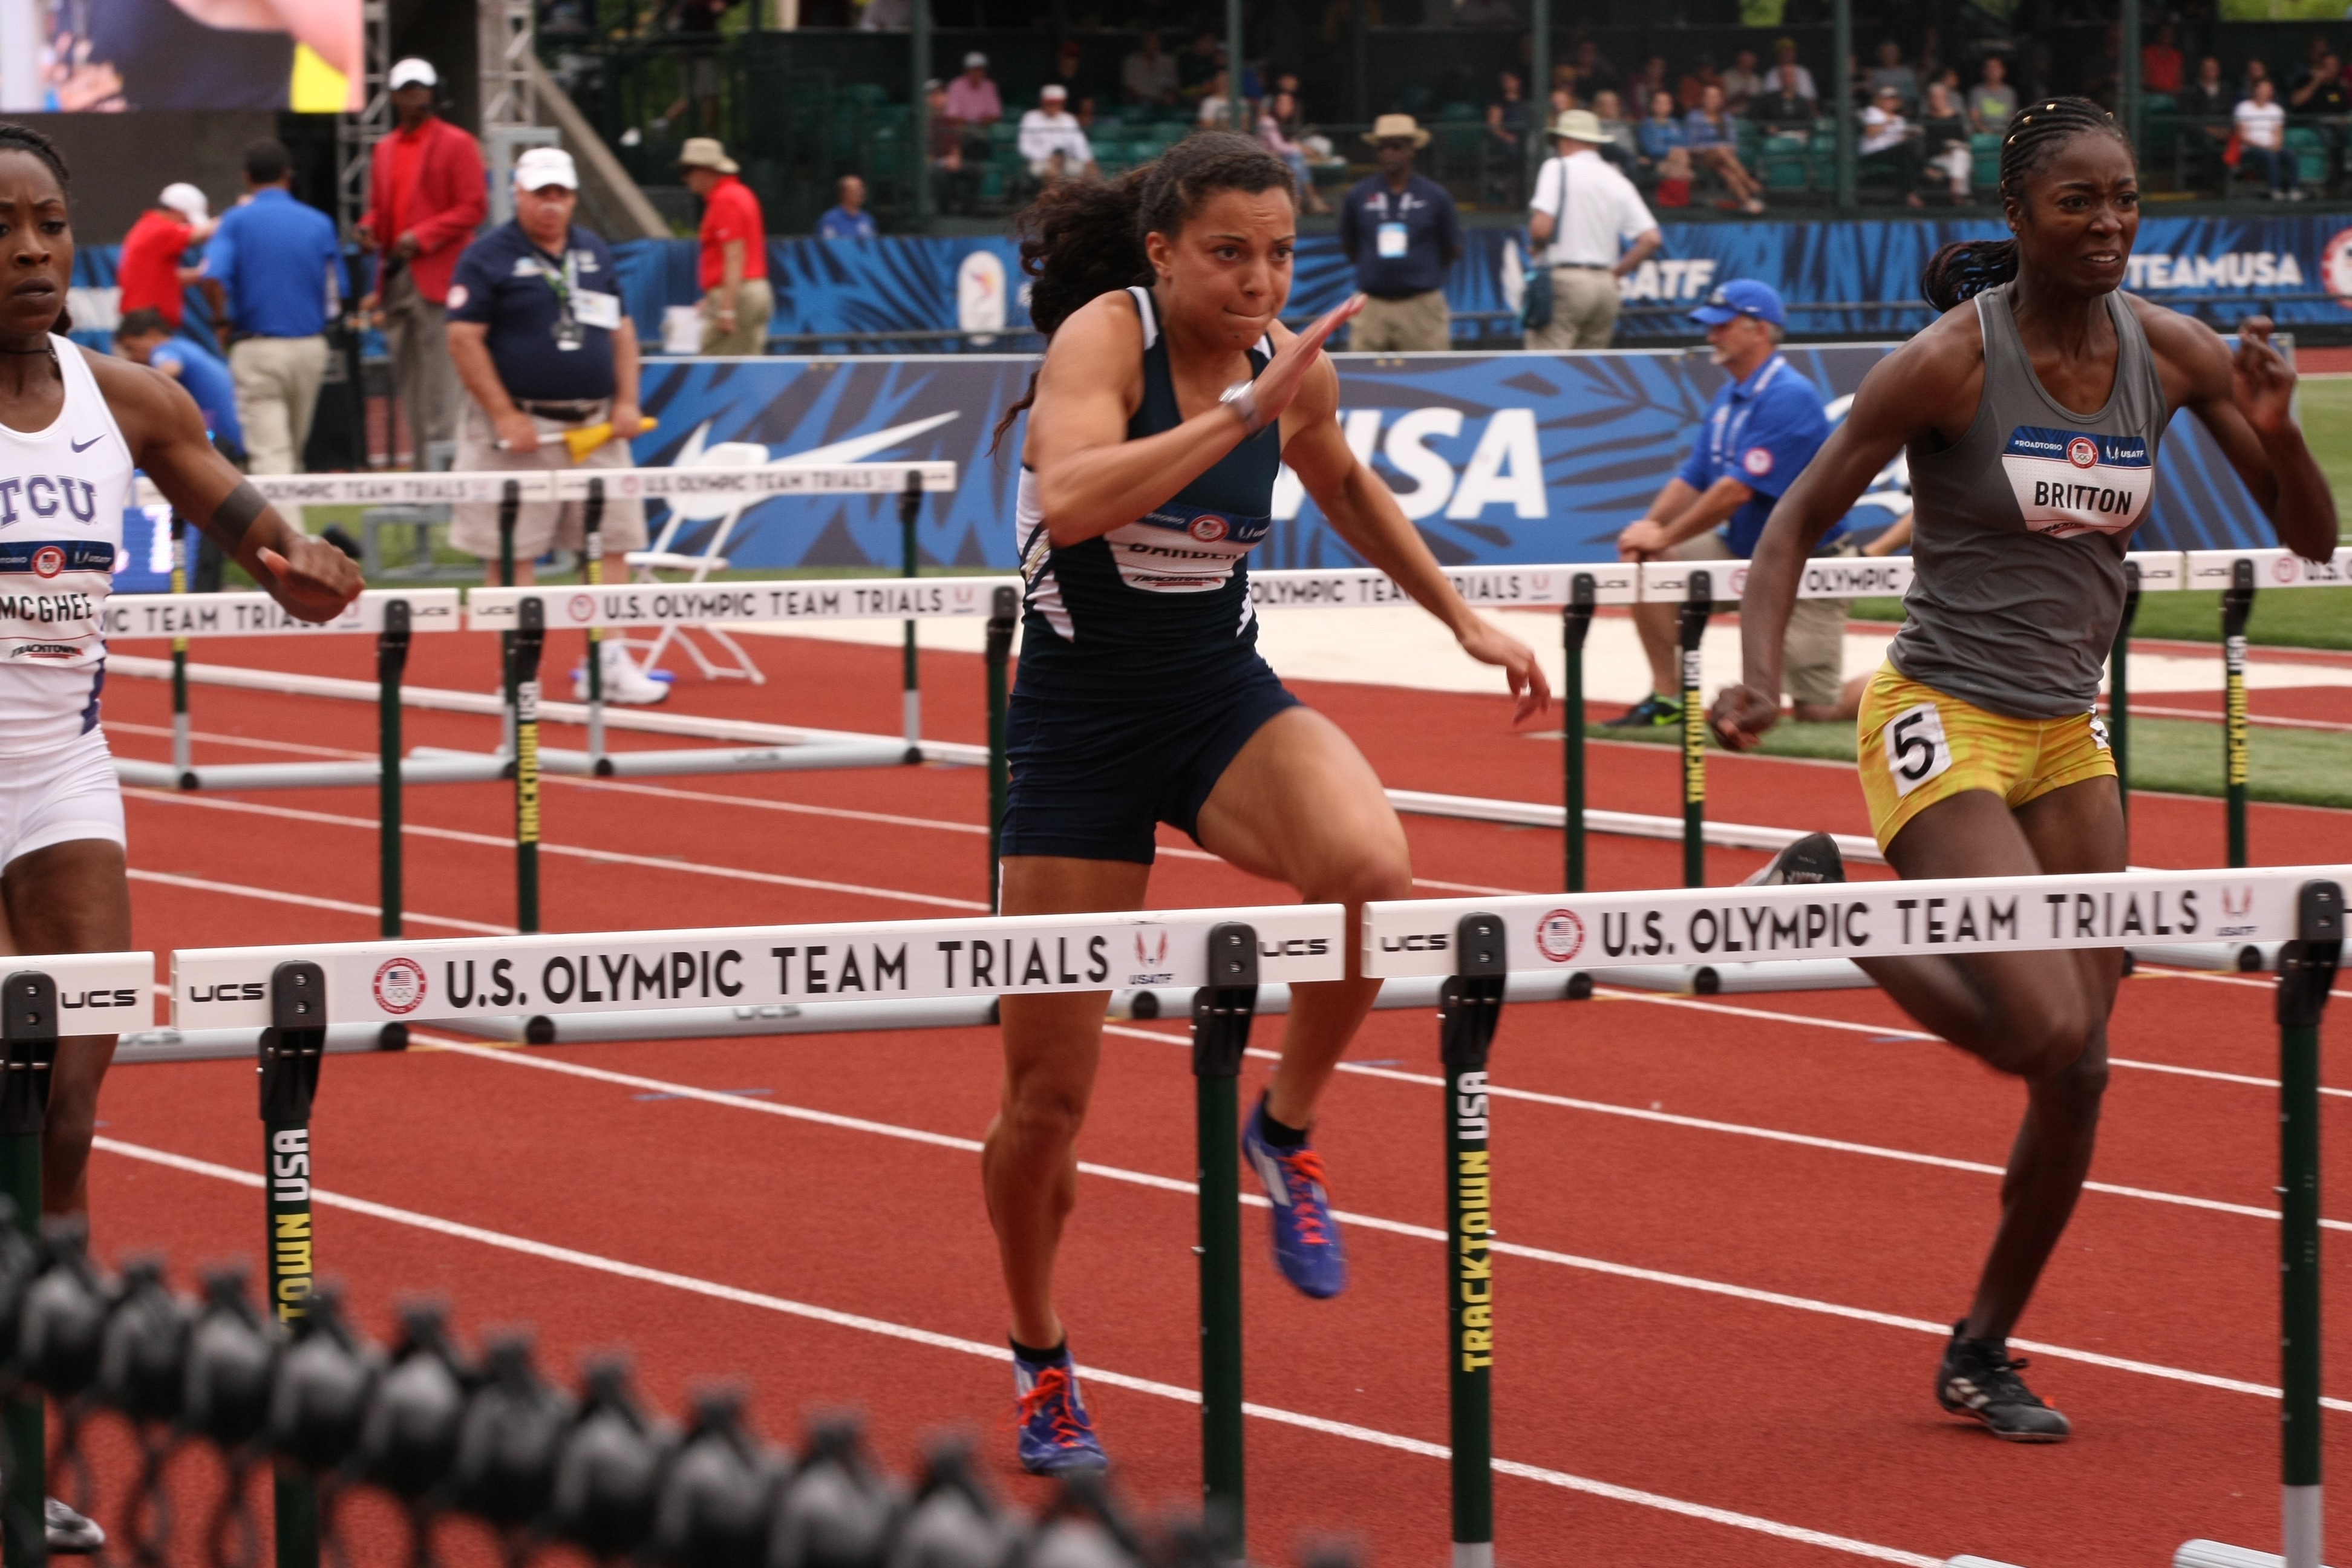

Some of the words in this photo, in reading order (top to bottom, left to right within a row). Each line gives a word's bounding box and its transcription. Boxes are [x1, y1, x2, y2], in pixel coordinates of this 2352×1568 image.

[2015, 440, 2063, 451] #ROADTORIO
[2120, 449, 2145, 459] USATF
[344, 482, 394, 499] TEAM
[754, 471, 803, 489] TEAM
[812, 469, 872, 488] TRIALS
[0, 474, 97, 529] TCU
[2034, 481, 2132, 515] BRITTON
[1250, 578, 1345, 604] OLYMPIC
[1805, 567, 1898, 592] OLYMPIC
[0, 593, 93, 622] MCGHEE
[606, 595, 647, 619] U.S.
[653, 592, 755, 618] OLYMPIC
[771, 590, 840, 616] TEAM
[855, 587, 943, 613] TRIALS
[146, 606, 219, 633] TEAM
[1894, 712, 1935, 780] 5
[1599, 910, 1677, 958] U.S.
[1688, 901, 1872, 954] OLYMPIC
[1893, 895, 2020, 945] TEAM
[2043, 889, 2200, 939] TRIALS
[1259, 938, 1332, 957] UCS
[1380, 933, 1452, 952] UCS
[445, 958, 528, 1008] U.S.
[541, 950, 744, 1004] OLYMPIC
[771, 941, 907, 995] TEAM
[936, 935, 1110, 988] TRIALS
[61, 988, 139, 1009] UCS
[189, 982, 267, 1002] UCS
[1457, 1071, 1490, 1140] USA
[273, 1128, 310, 1201] USA
[1458, 1150, 1494, 1373] TRACKTOWN
